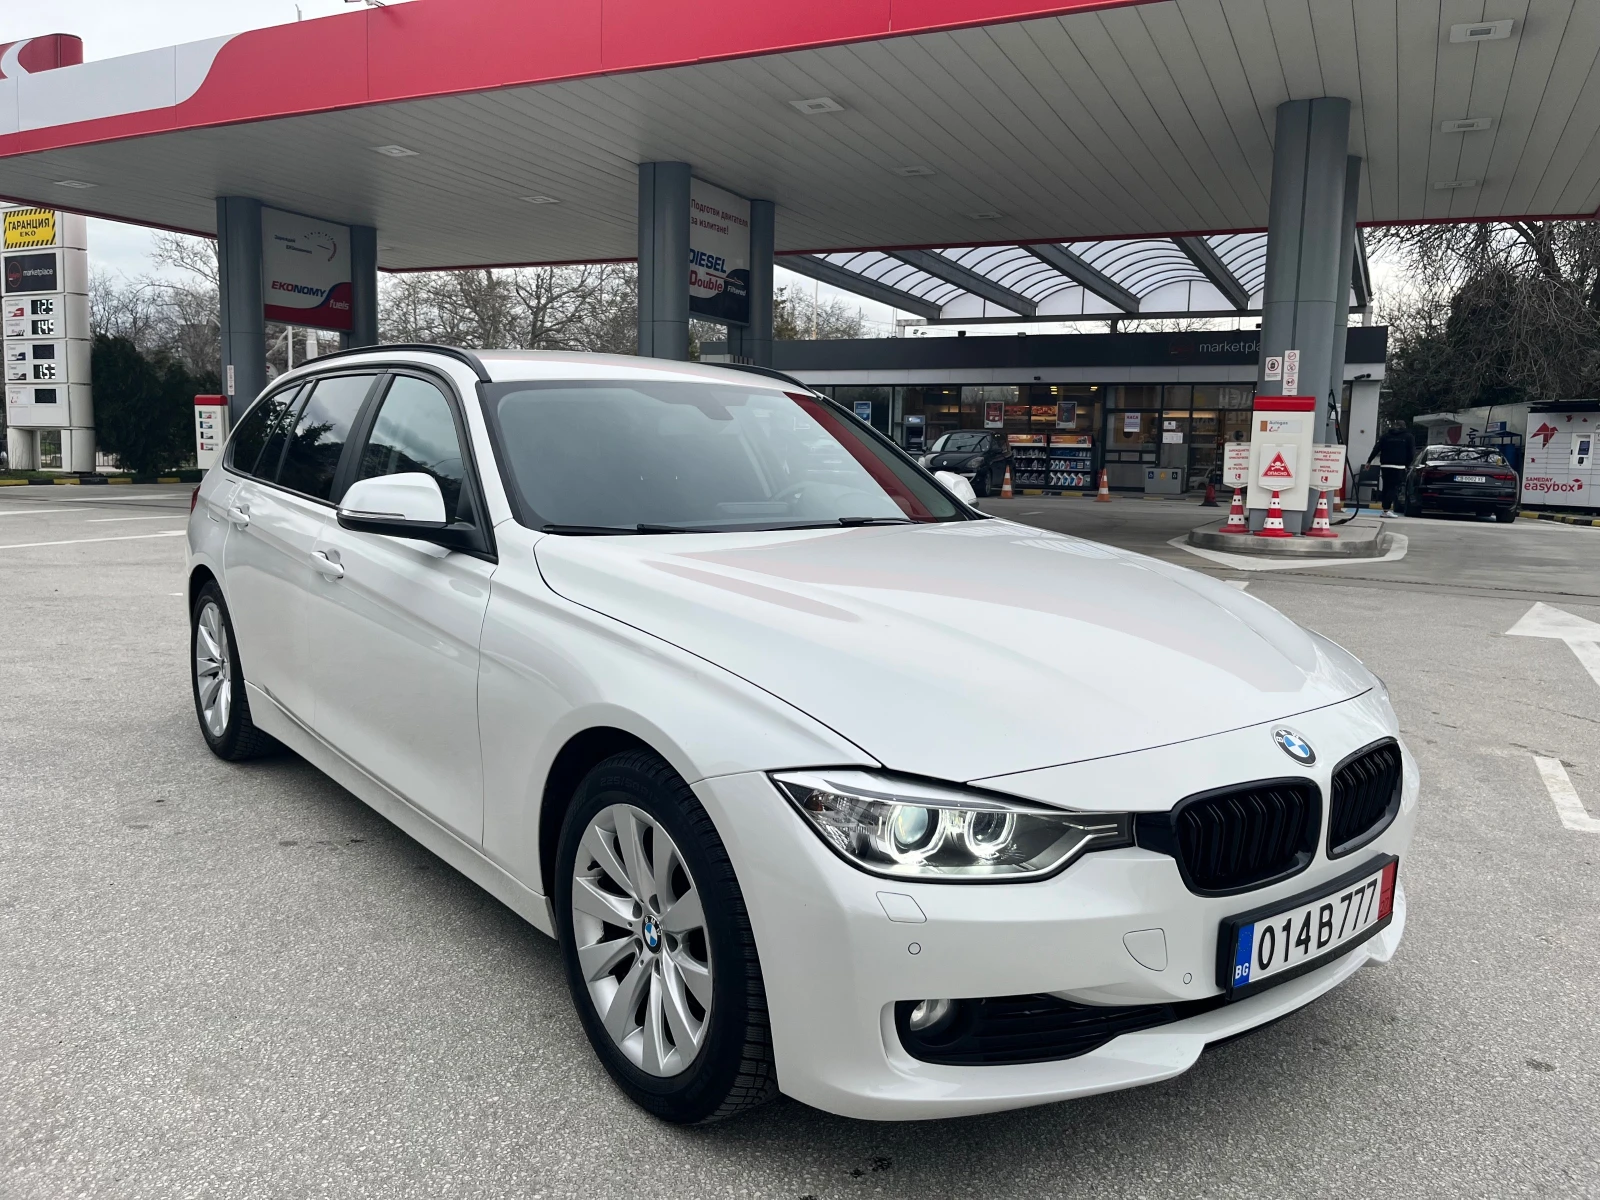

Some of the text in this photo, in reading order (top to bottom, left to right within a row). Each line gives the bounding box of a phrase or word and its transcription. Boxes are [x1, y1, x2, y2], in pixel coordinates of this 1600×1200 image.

[690, 198, 748, 228] Подготви двигателя
[8, 218, 50, 231] ГАРАНЦИЯ
[690, 216, 729, 235] за излитане!
[690, 248, 727, 274] DIESEL
[23, 268, 54, 277] marketplace
[271, 280, 326, 297] EKONOMY
[690, 270, 747, 296] Double Filtered
[329, 299, 349, 310] fuels
[1524, 481, 1575, 493] easybox
[1235, 962, 1249, 980] BG
